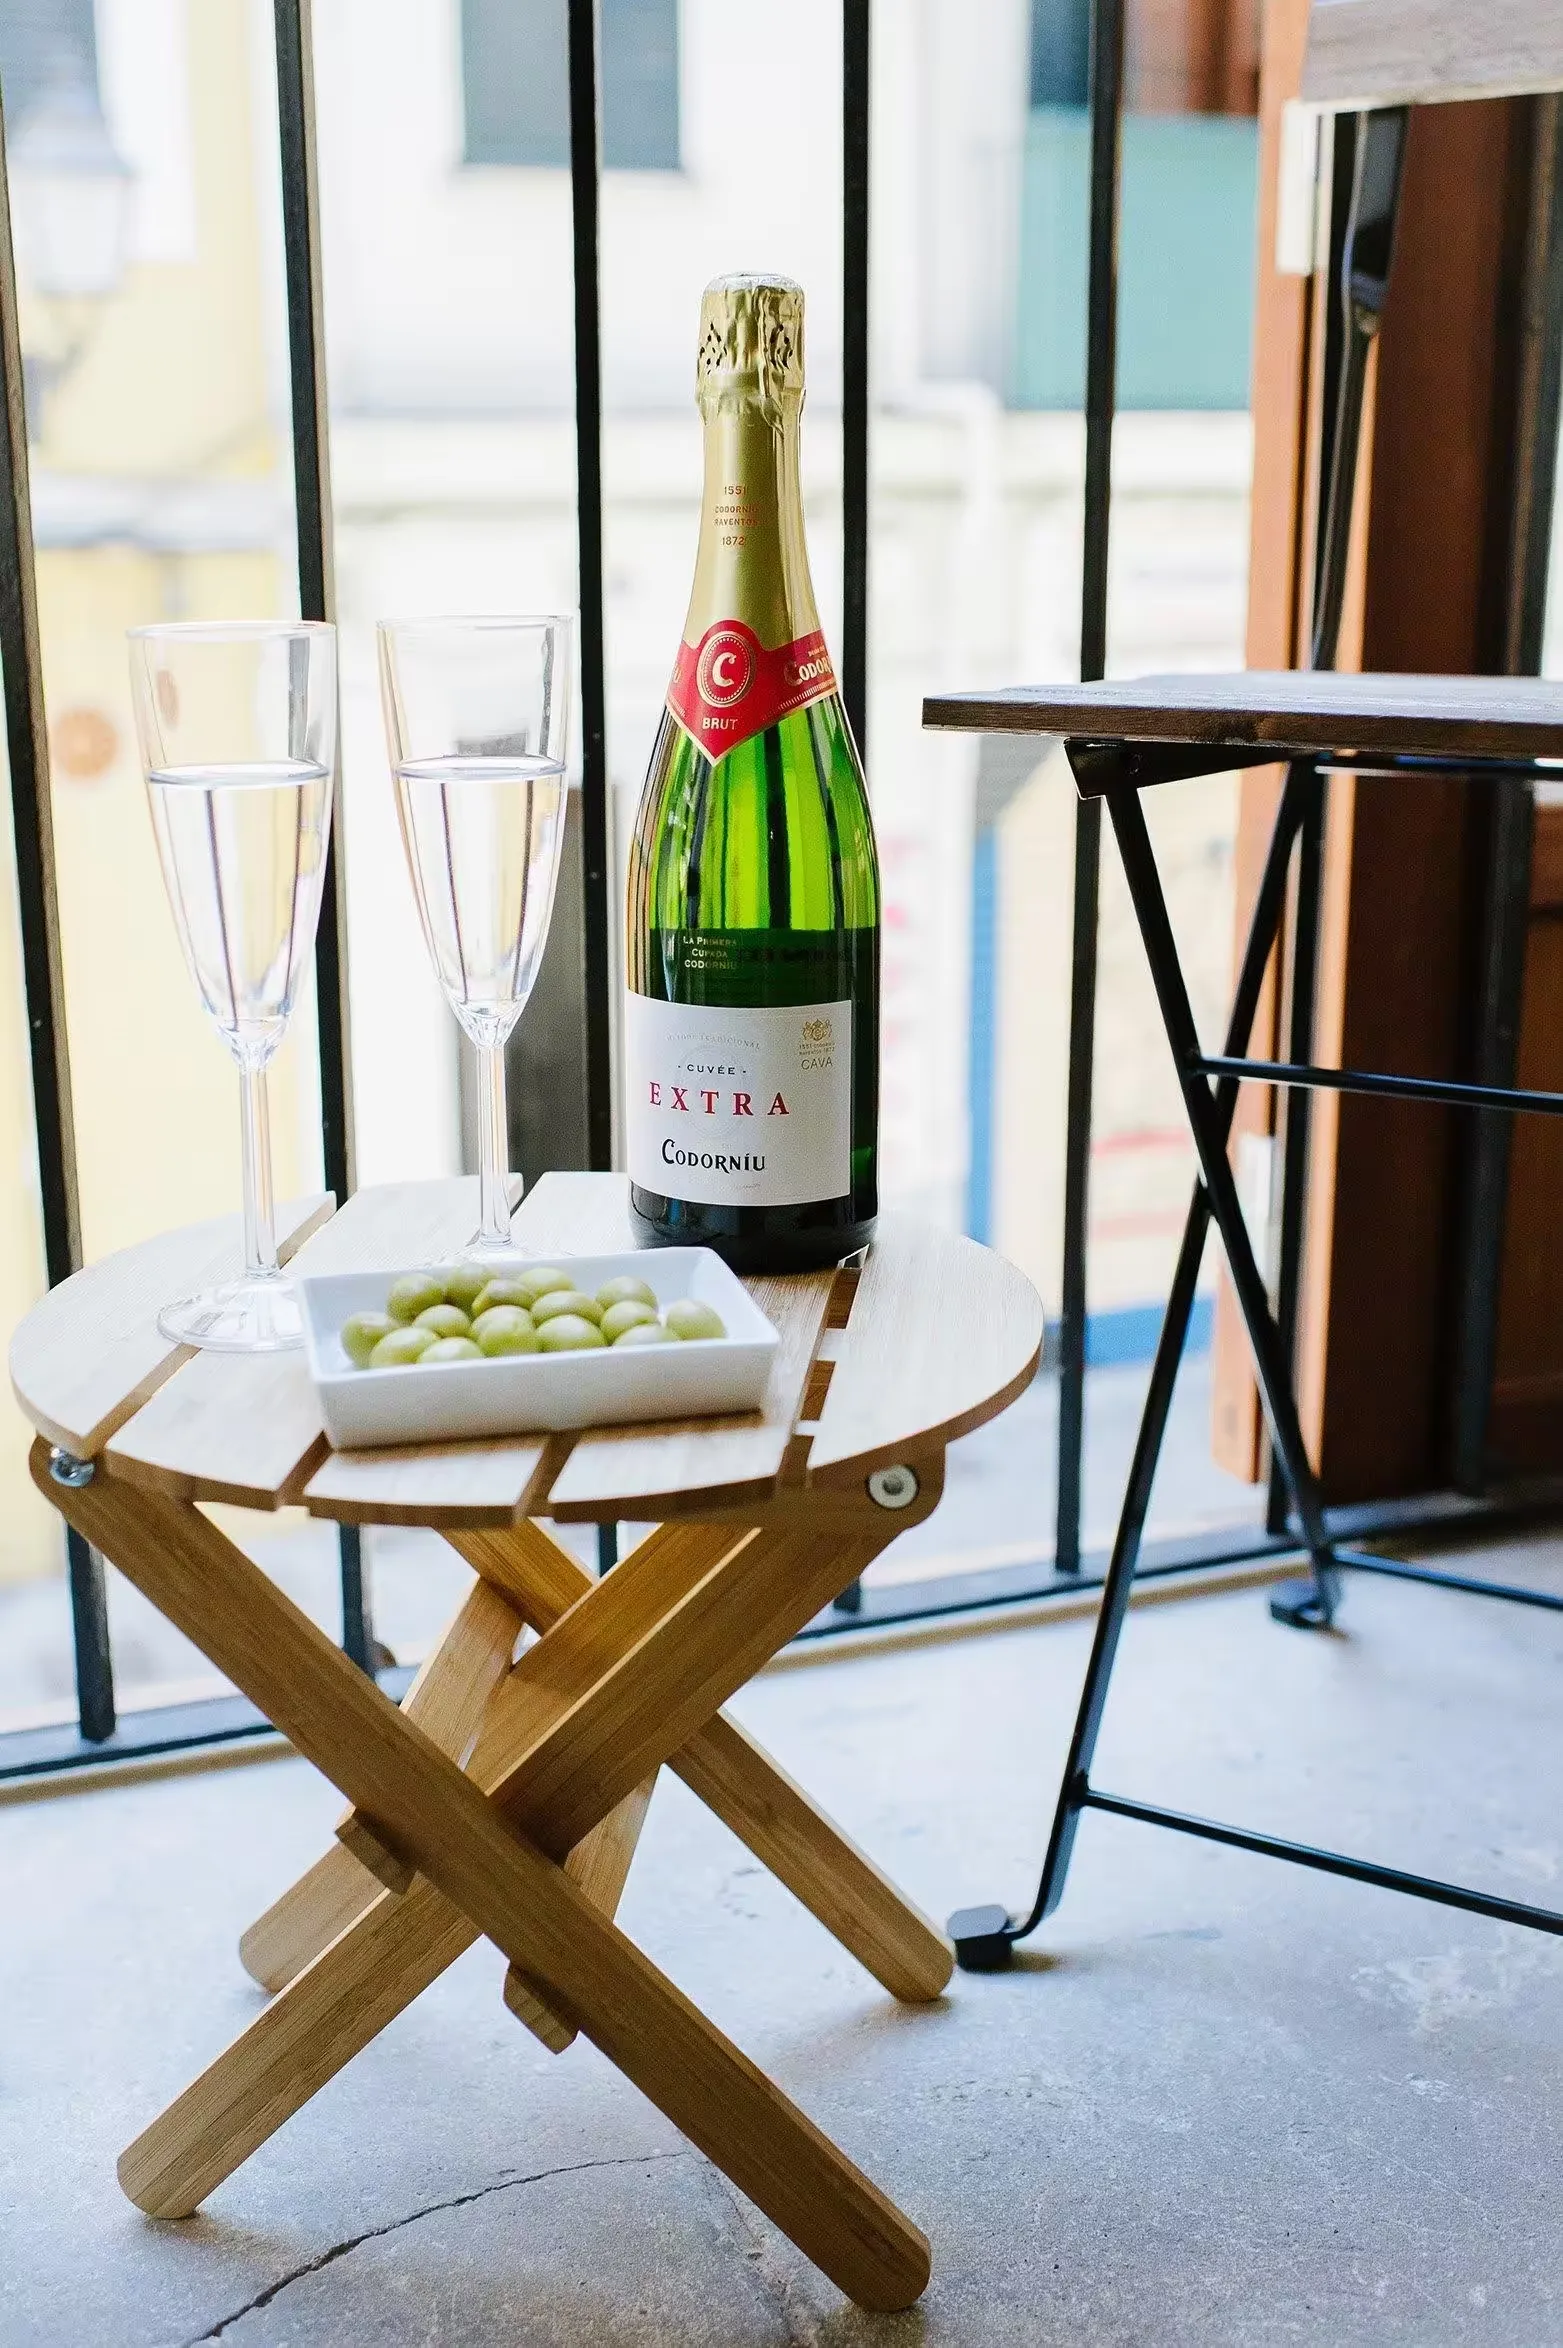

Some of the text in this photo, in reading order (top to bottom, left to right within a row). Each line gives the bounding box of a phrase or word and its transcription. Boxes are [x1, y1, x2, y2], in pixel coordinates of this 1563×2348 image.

[724, 485, 747, 495] 1551
[722, 536, 745, 546] 1872
[712, 652, 736, 687] C
[784, 655, 833, 687] CODOR
[702, 717, 739, 730] BRUT
[683, 936, 694, 945] LA
[686, 1064, 735, 1075] CUVÉE
[801, 1057, 833, 1070] CAVA
[650, 1082, 789, 1116] EXTRA
[662, 1138, 765, 1174] CODORNÍU
